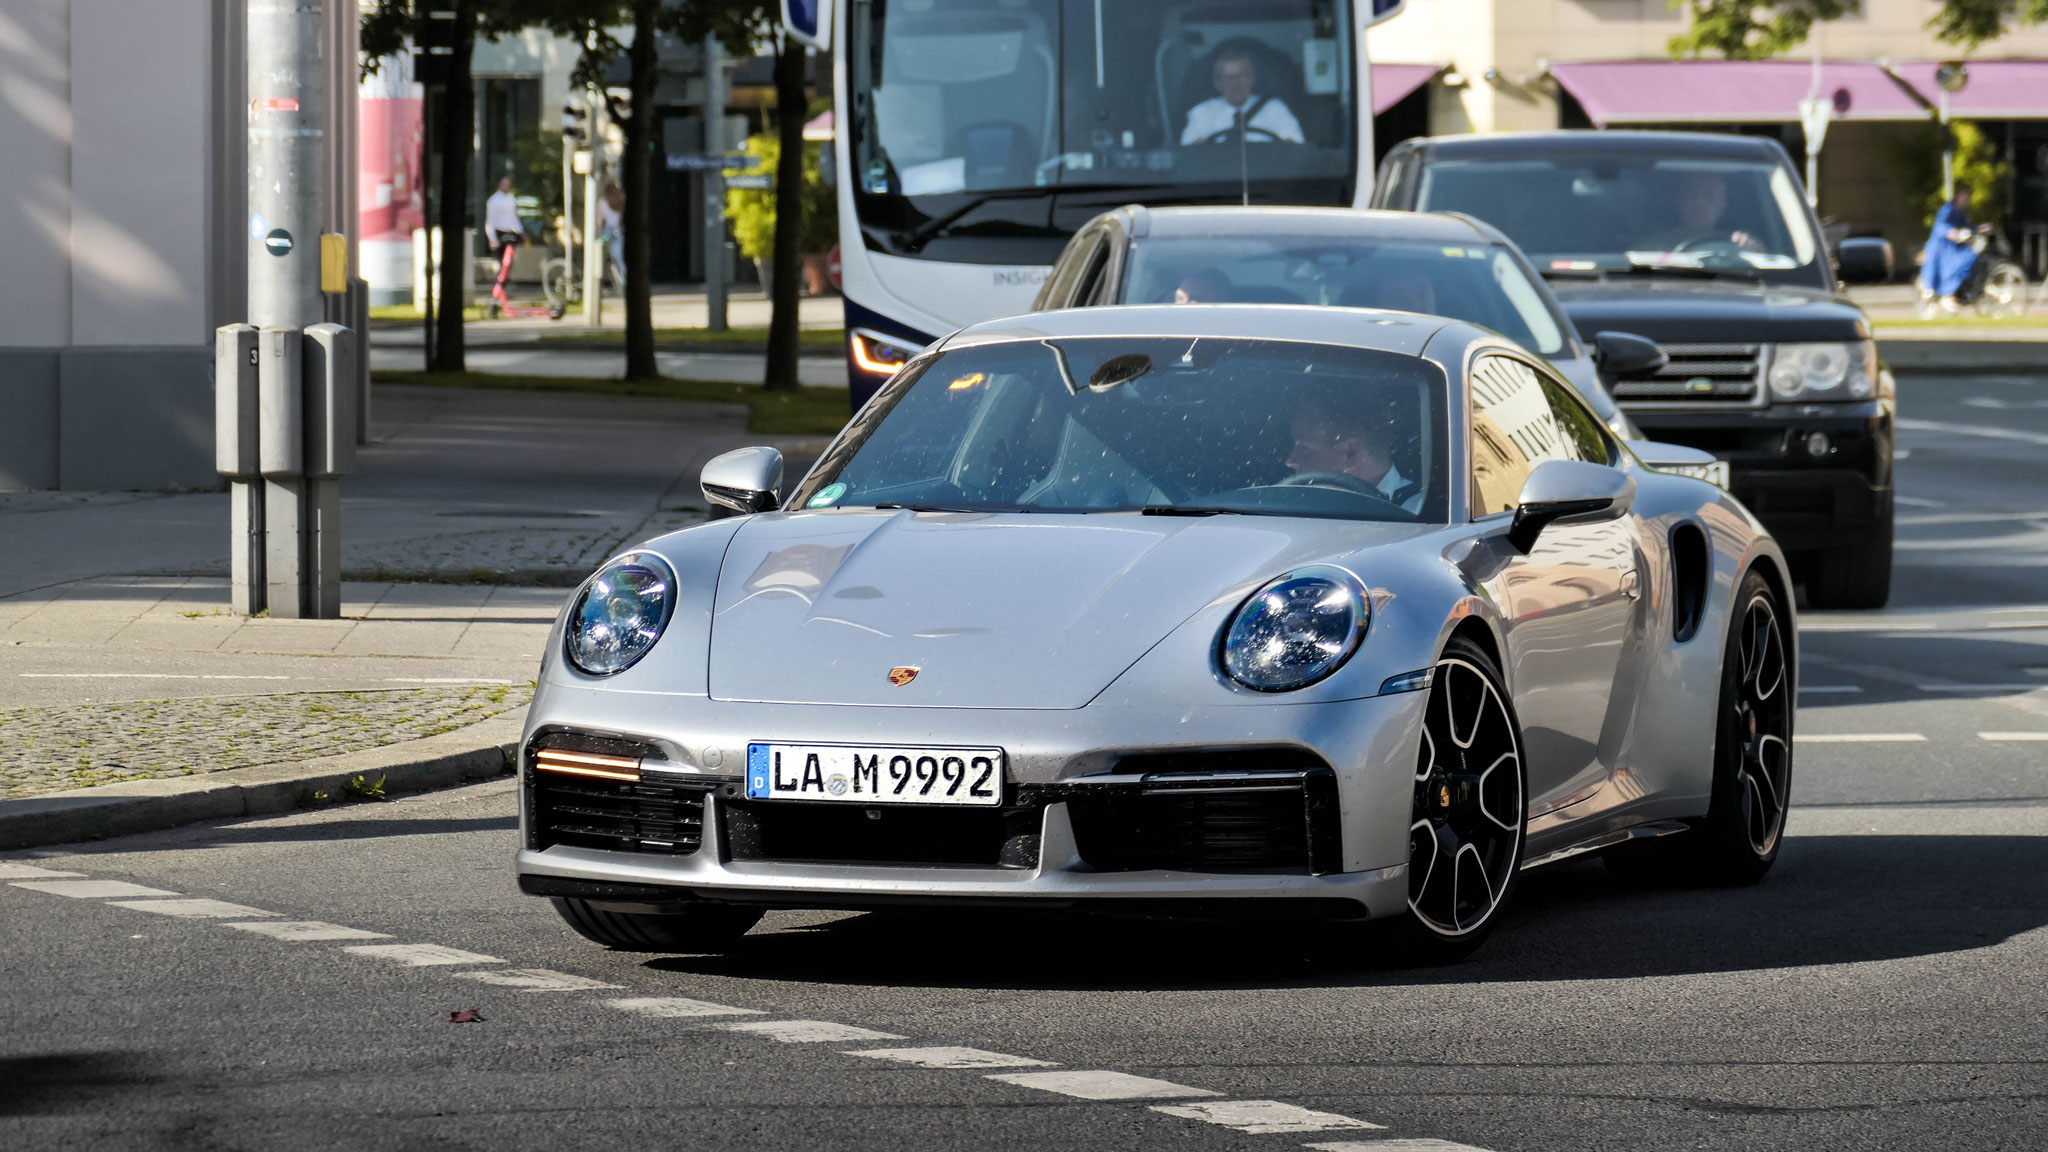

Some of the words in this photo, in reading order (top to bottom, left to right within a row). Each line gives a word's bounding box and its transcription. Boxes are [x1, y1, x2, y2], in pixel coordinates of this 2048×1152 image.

[251, 349, 258, 364] 3
[775, 752, 824, 792] LA
[755, 777, 764, 788] D
